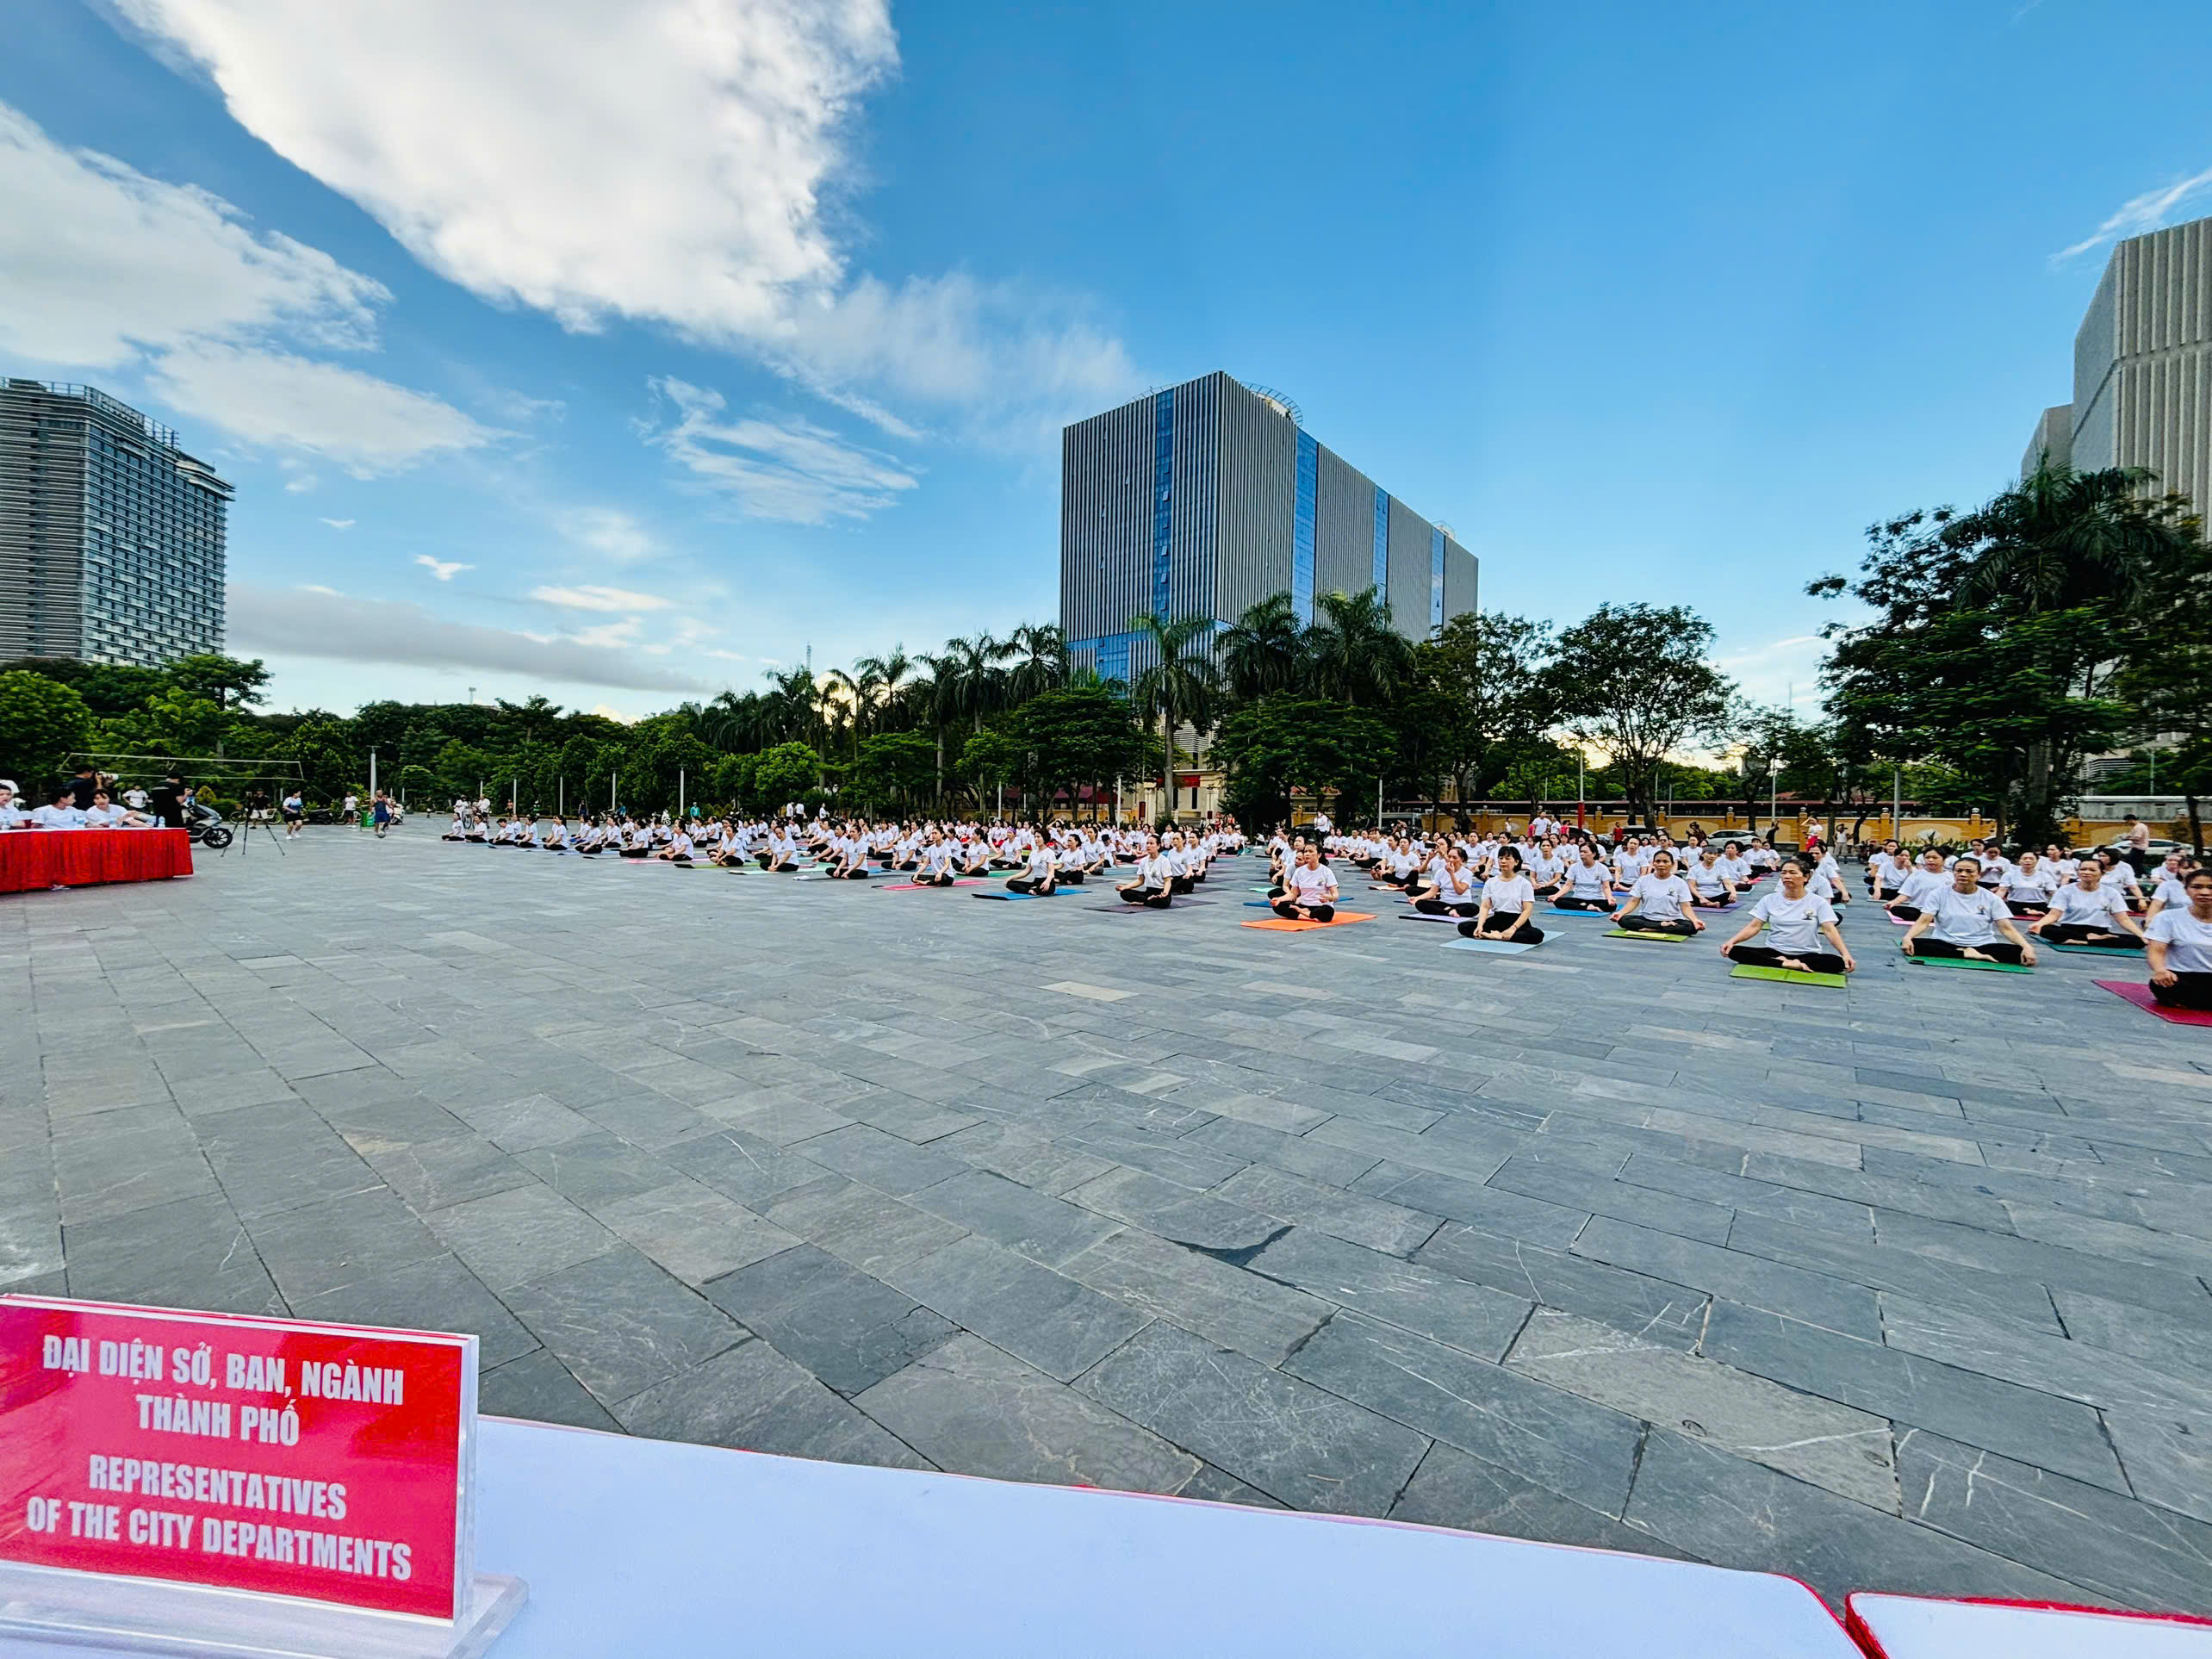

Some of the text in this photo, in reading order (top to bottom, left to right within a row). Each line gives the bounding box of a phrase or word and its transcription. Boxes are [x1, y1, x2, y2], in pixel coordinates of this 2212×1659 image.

[43, 1334, 404, 1405] ĐẠI DIỆN SỞ, BAN, NGÀNH
[136, 1393, 300, 1446] THÀNH PHỐ
[89, 1454, 346, 1519] REPRESENTATIVES
[27, 1496, 412, 1581] OF THE CITY DEPARTMENTS
